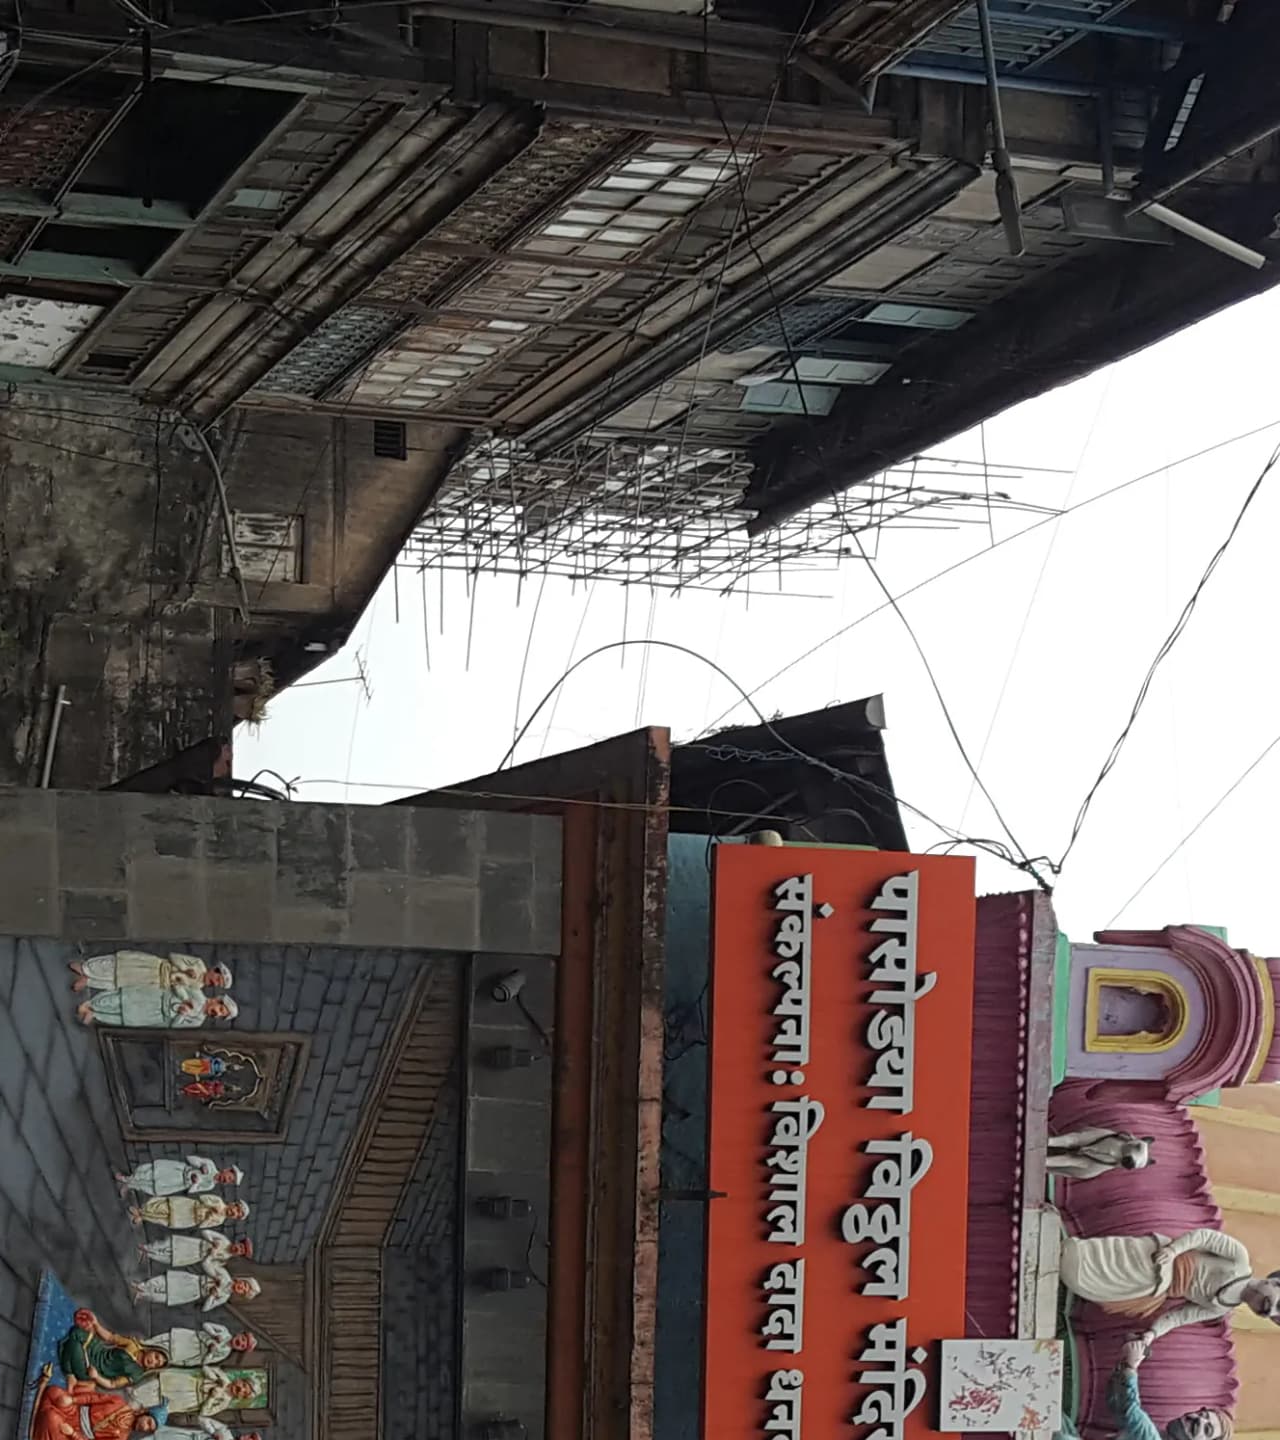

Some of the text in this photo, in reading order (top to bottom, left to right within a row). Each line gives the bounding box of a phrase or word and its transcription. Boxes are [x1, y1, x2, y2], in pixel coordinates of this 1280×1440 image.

[766, 1095, 825, 1246] विशाल
[841, 1131, 933, 1301] विठ्ठल
[762, 1259, 805, 1354] दादा
